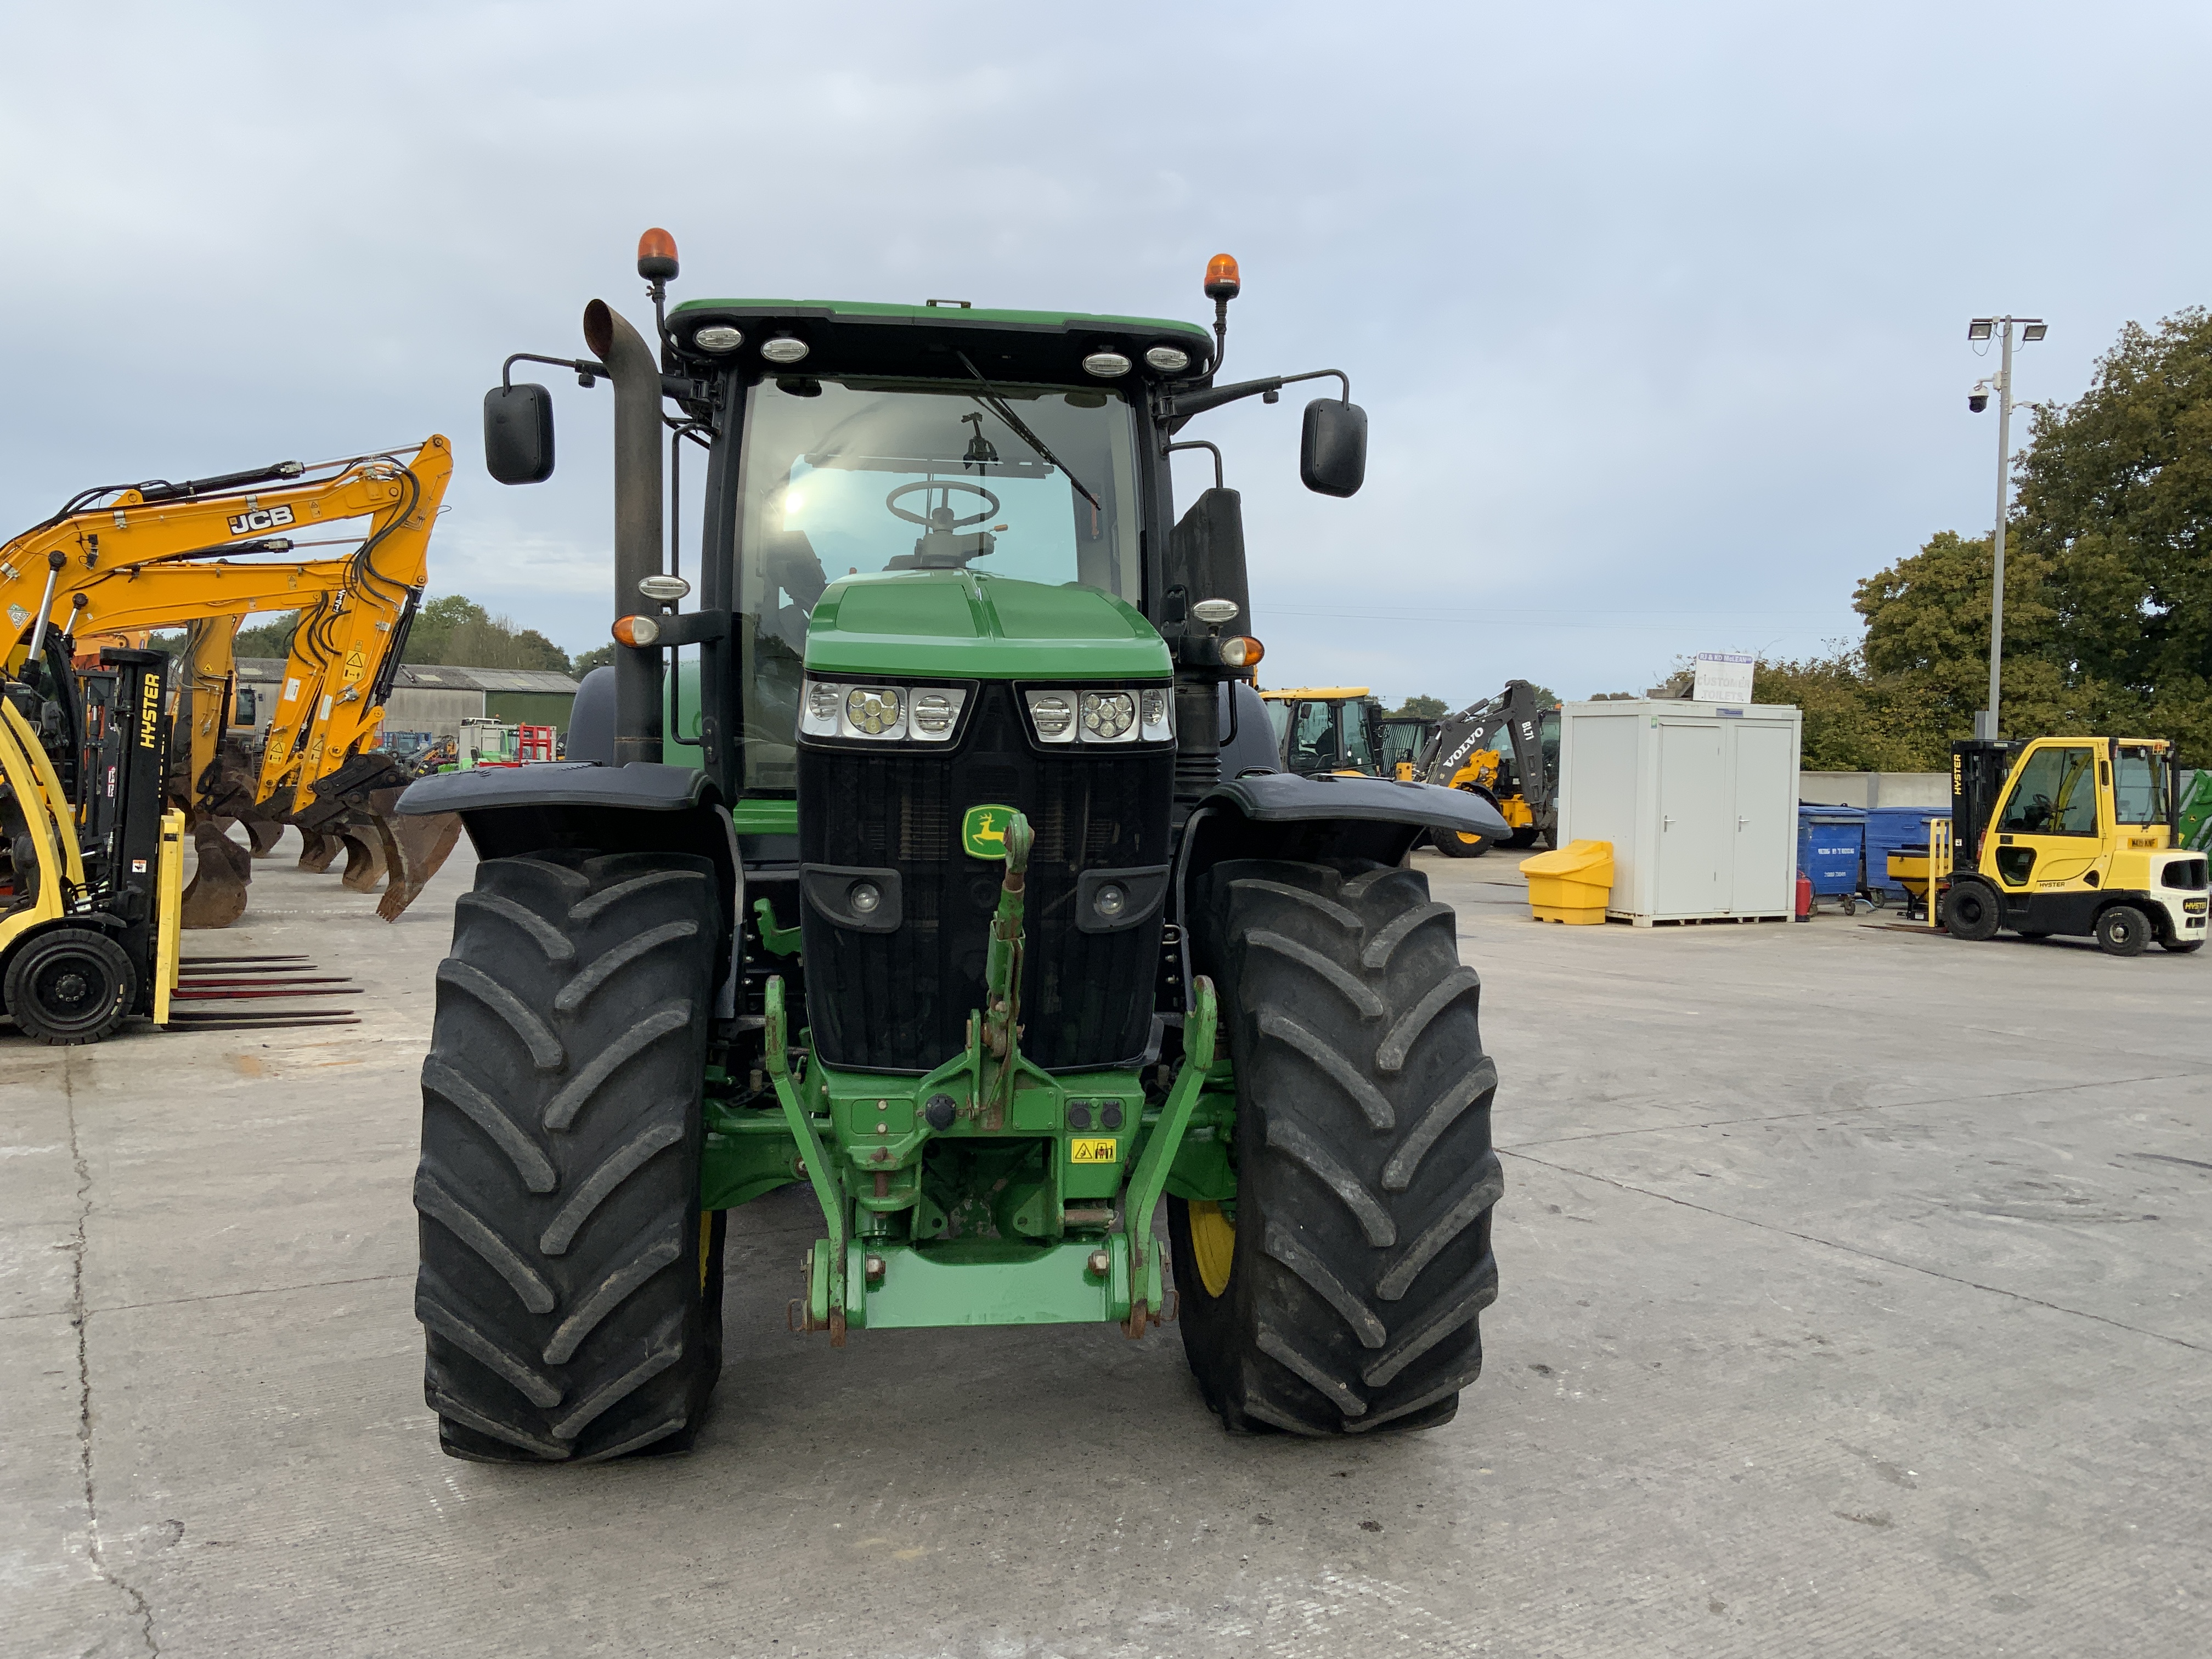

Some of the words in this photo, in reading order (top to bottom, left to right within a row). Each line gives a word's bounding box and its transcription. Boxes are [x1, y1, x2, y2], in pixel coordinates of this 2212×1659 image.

[230, 506, 294, 534] JCB
[1696, 676, 1750, 689] CUSTOMER
[1702, 690, 1743, 701] TOILETS
[140, 673, 160, 748] HYSTER
[1521, 721, 1534, 741] BL71
[1443, 727, 1484, 768] VOLVO
[1954, 754, 1962, 795] HYSTER
